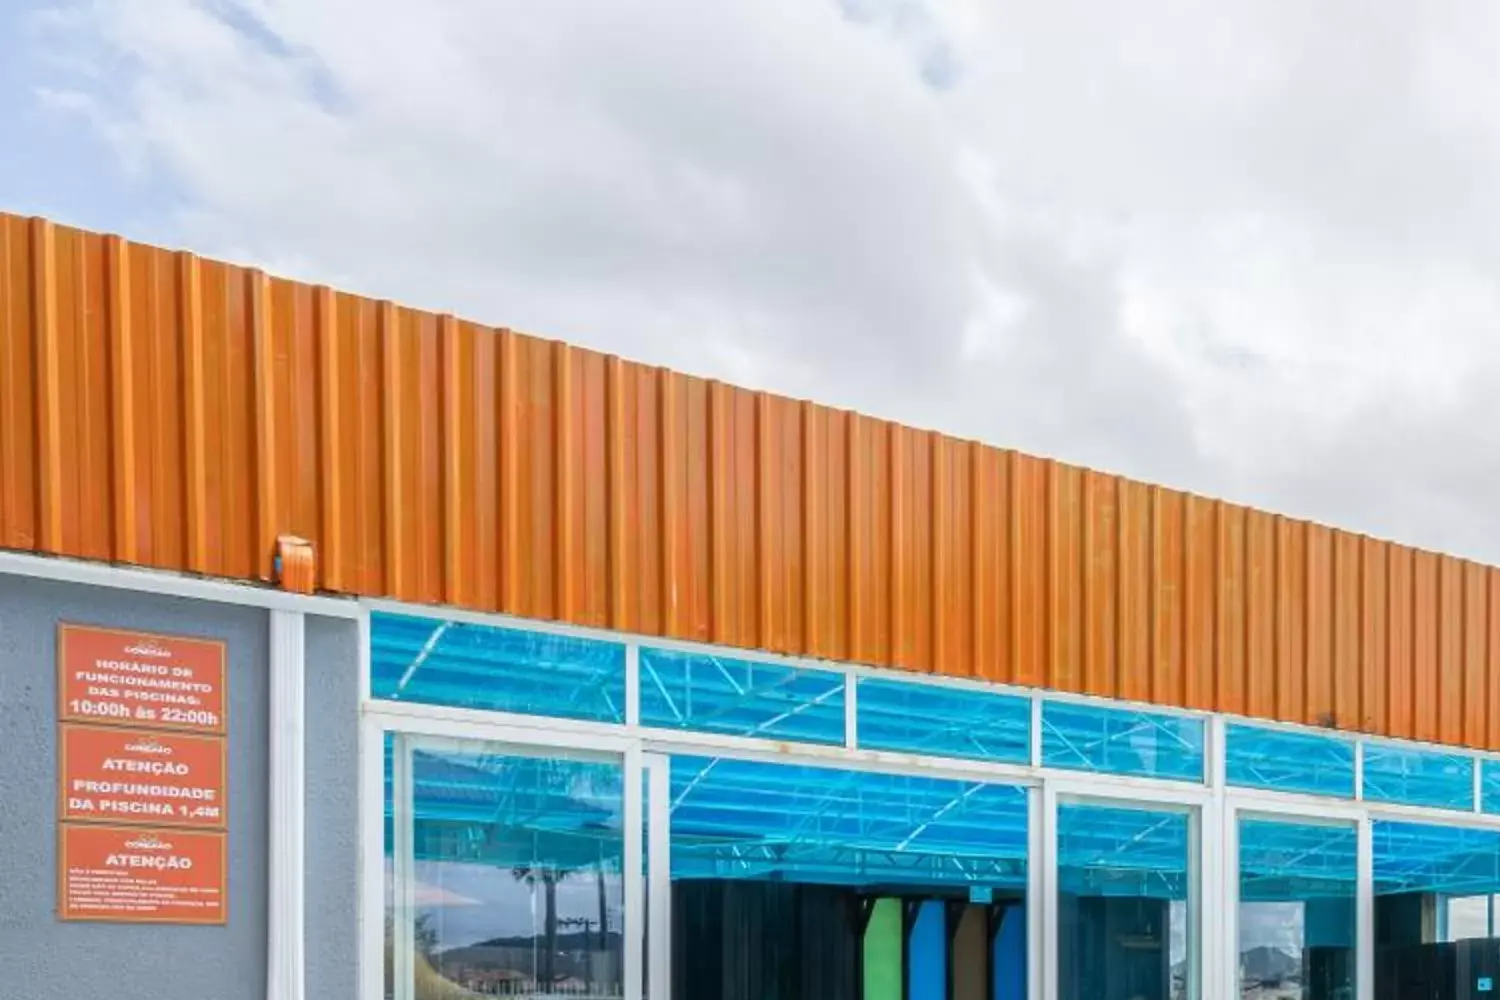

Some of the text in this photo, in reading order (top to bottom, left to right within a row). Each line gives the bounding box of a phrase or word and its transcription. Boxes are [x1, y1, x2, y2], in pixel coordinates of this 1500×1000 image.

[75, 672, 212, 692] FUNCIONAMENTO
[88, 686, 120, 698] DAS
[70, 699, 130, 718] 10:00h
[160, 708, 218, 726] 22:00h
[103, 758, 189, 776] ATENÇÃO
[73, 780, 216, 799] PROFUNDIDADE
[69, 798, 94, 810] DA
[100, 800, 174, 816] PISCINA
[106, 854, 192, 870] ATENÇÃO
